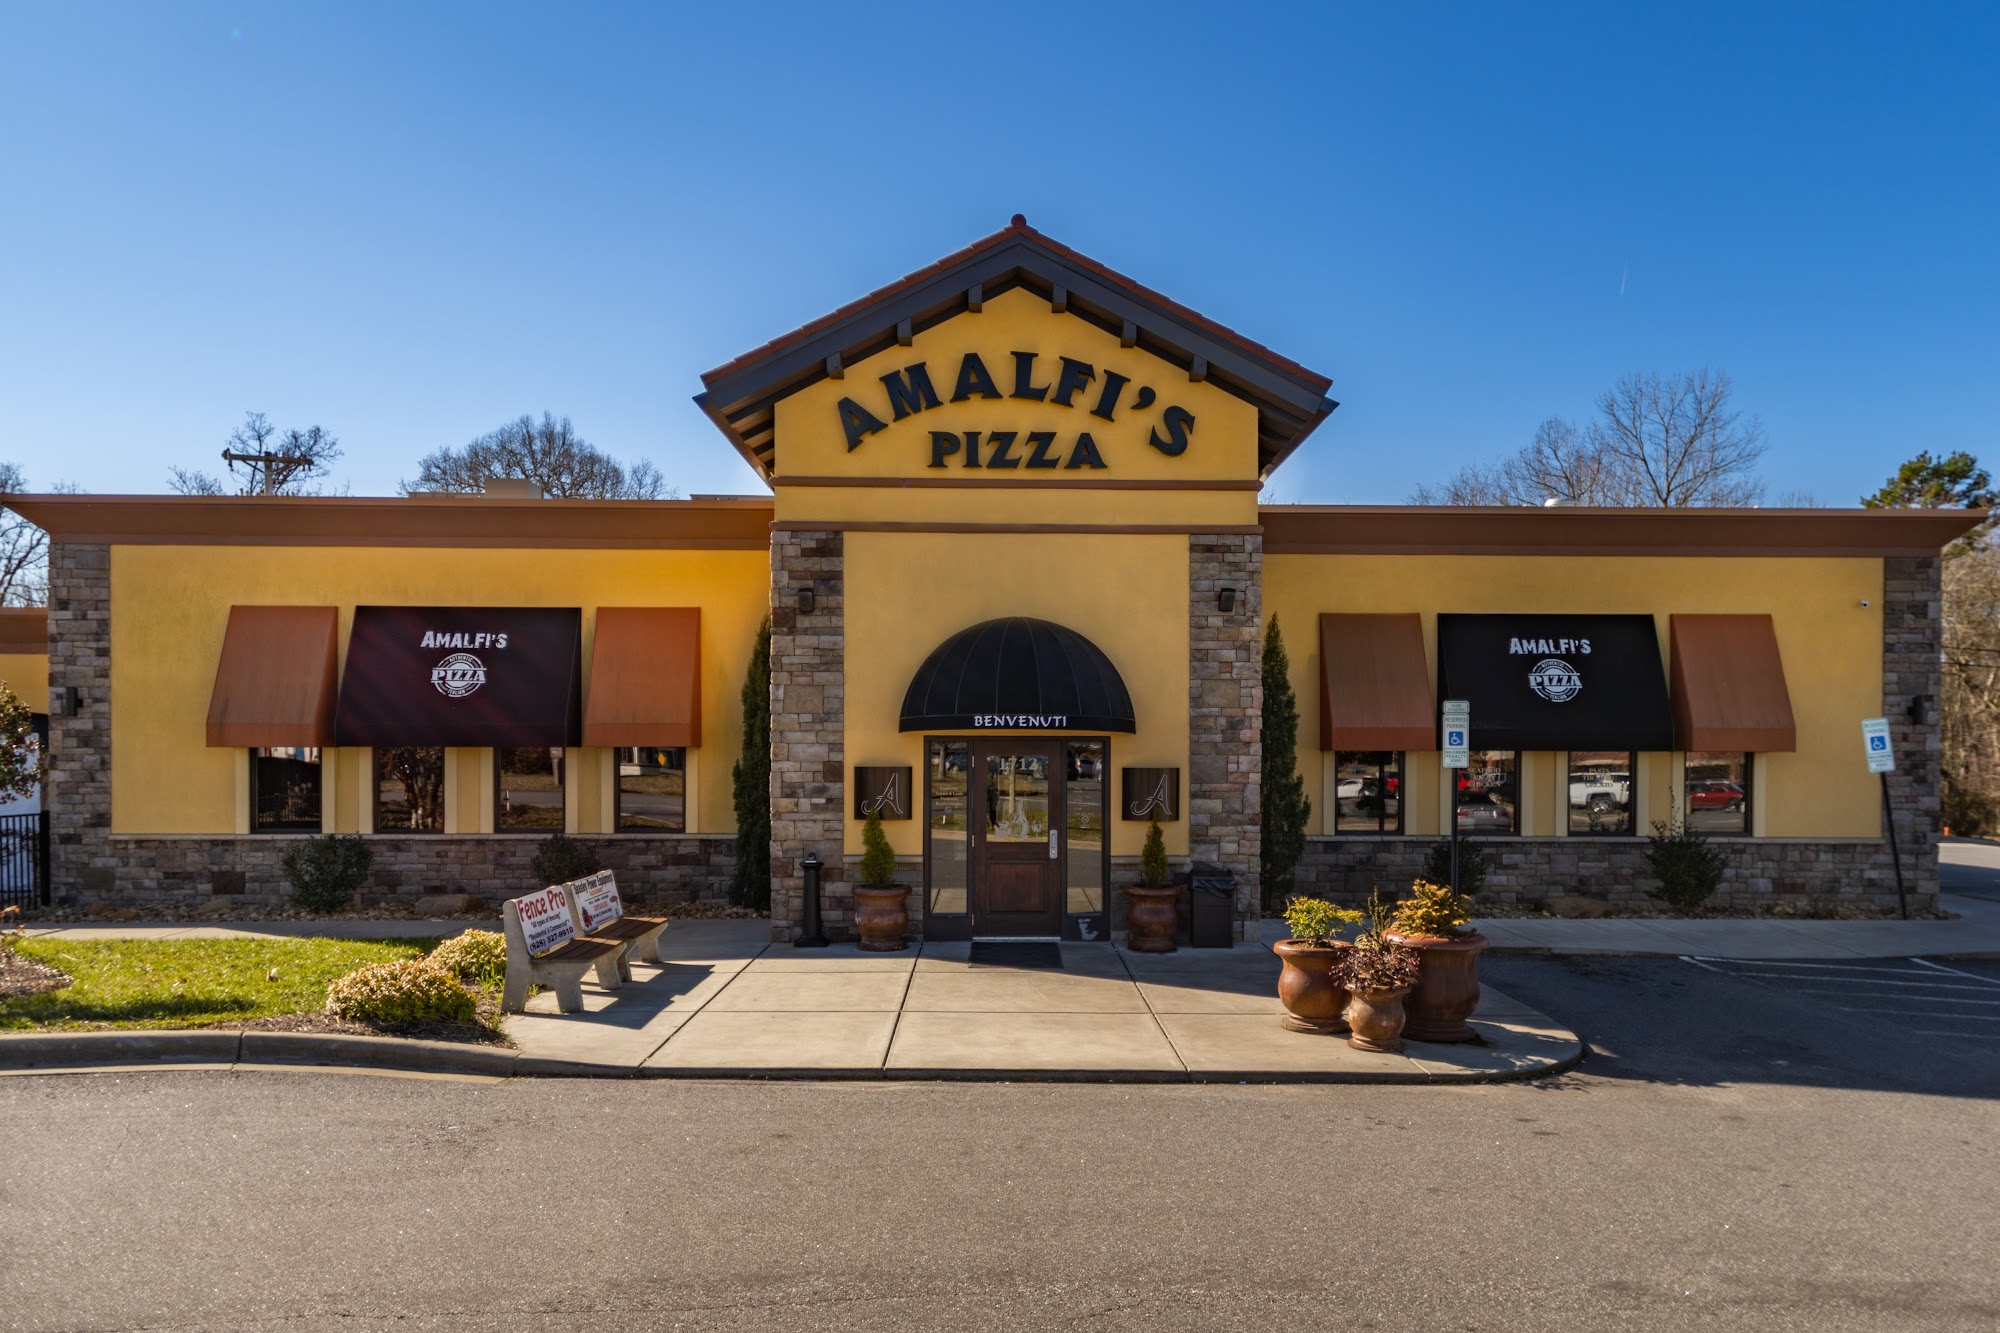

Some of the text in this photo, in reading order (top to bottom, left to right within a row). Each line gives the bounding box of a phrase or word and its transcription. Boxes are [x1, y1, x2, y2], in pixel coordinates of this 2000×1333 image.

[837, 350, 1196, 457] AMALFI'S
[927, 430, 1108, 470] PIZZA
[420, 630, 508, 649] AMALFI'S
[1509, 637, 1592, 655] AMALFI'S
[431, 669, 486, 681] PIZZA
[1528, 675, 1583, 686] PIZZA
[973, 715, 1067, 728] BENVENUTI
[999, 757, 1038, 771] 1712
[516, 899, 548, 922] Fence
[547, 889, 566, 912] Pro
